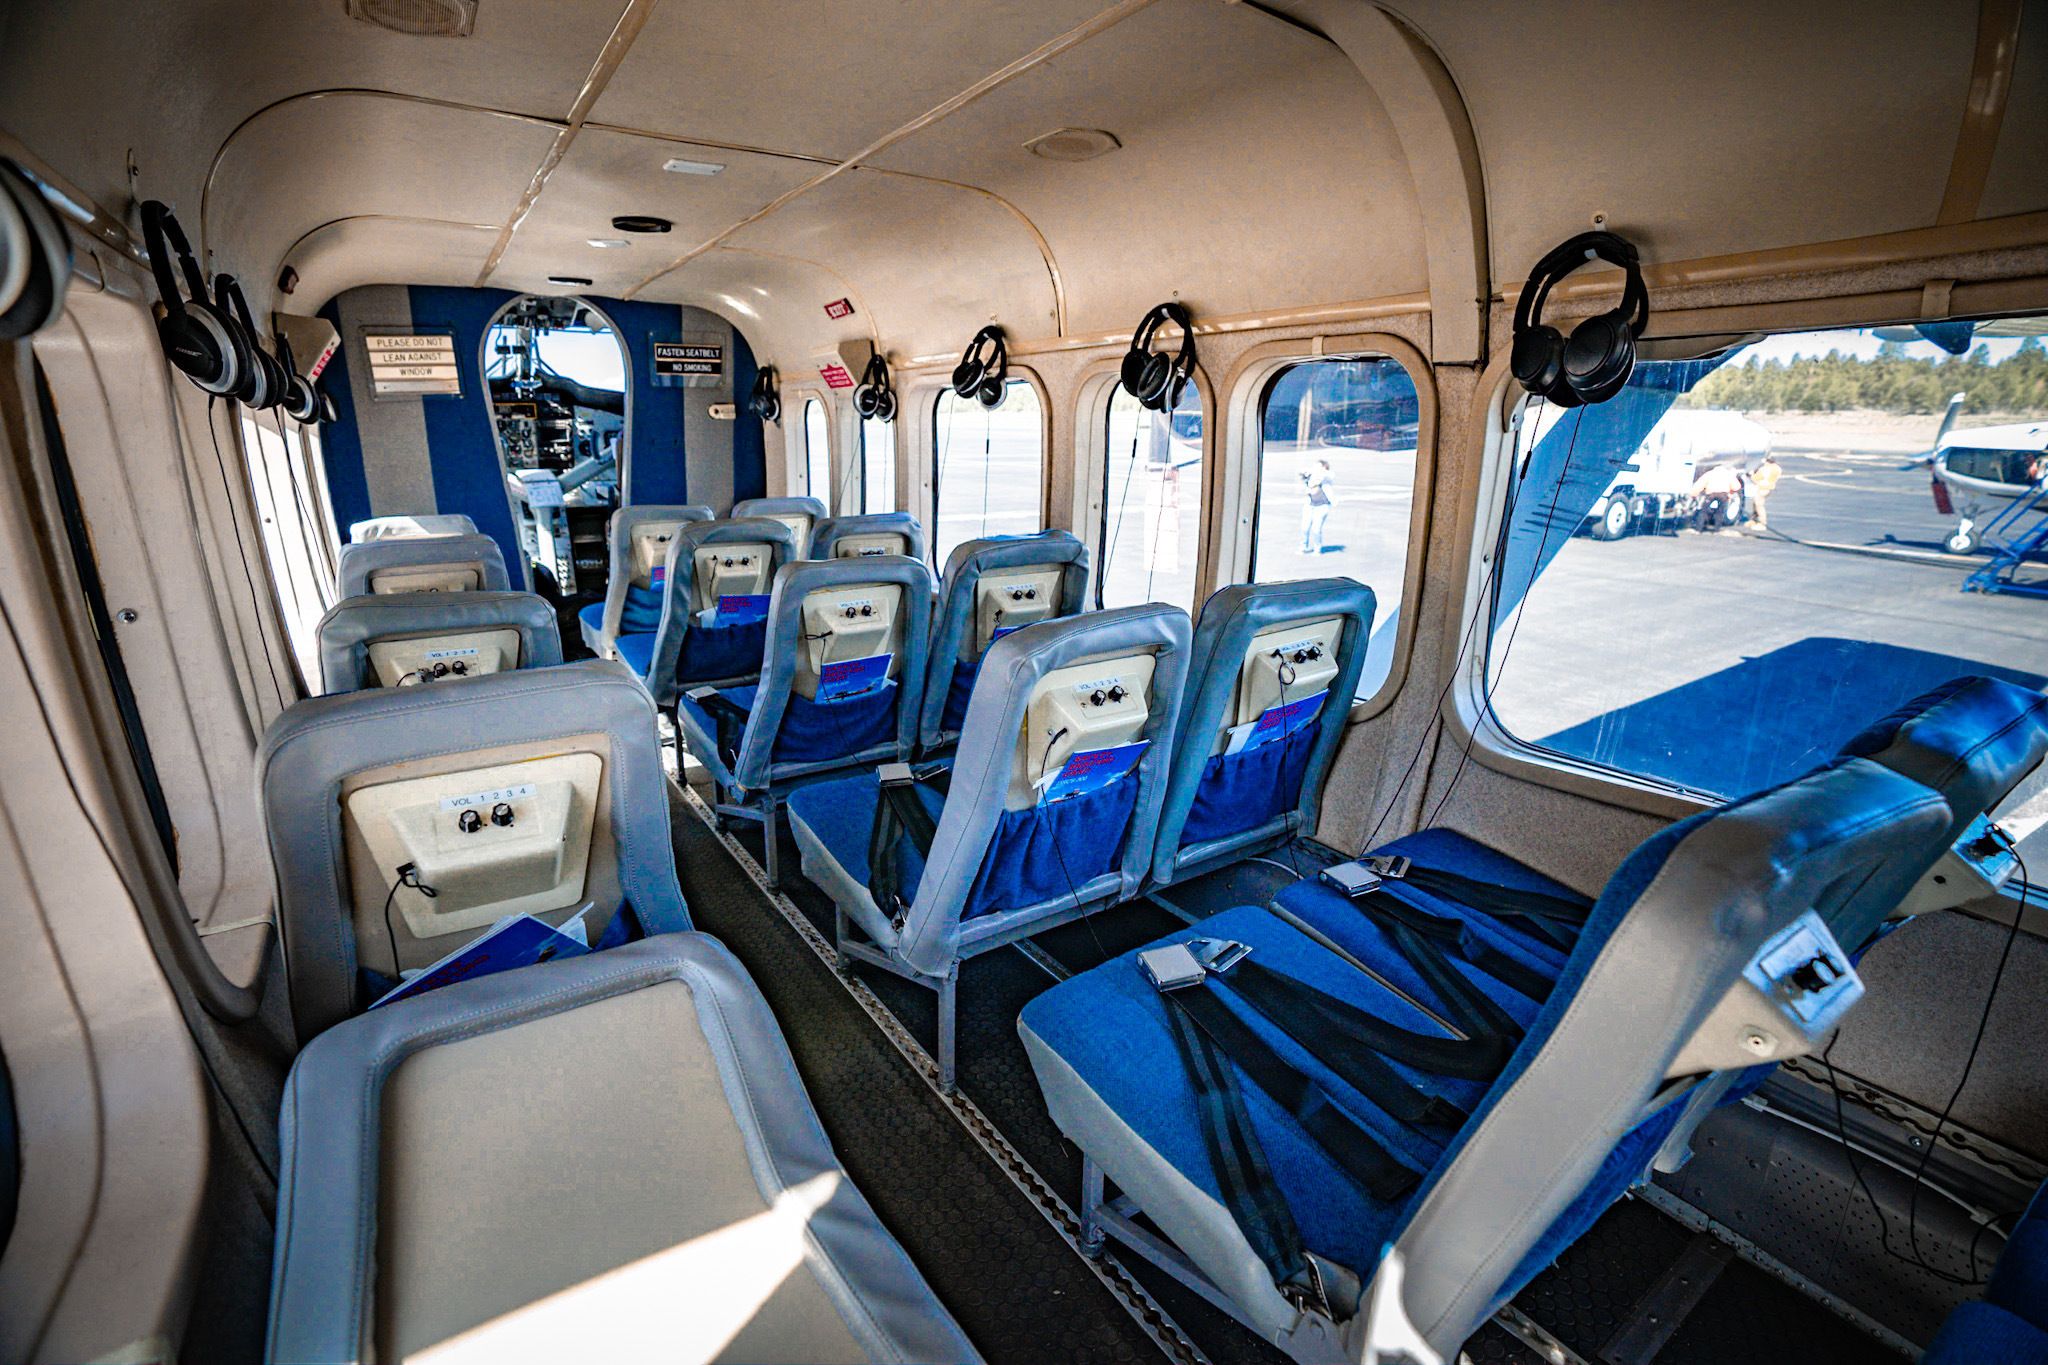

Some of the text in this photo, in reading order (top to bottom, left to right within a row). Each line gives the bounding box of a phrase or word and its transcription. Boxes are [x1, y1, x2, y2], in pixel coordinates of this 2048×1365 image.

[377, 337, 443, 347] PLEASE DO NOT
[383, 352, 441, 362] LEAN AGAINST
[657, 347, 720, 357] FASTEN SEATBELT
[400, 367, 432, 376] WINDOW
[672, 363, 712, 372] NO SMOKING
[451, 798, 472, 807] VOL
[493, 792, 499, 800] 2
